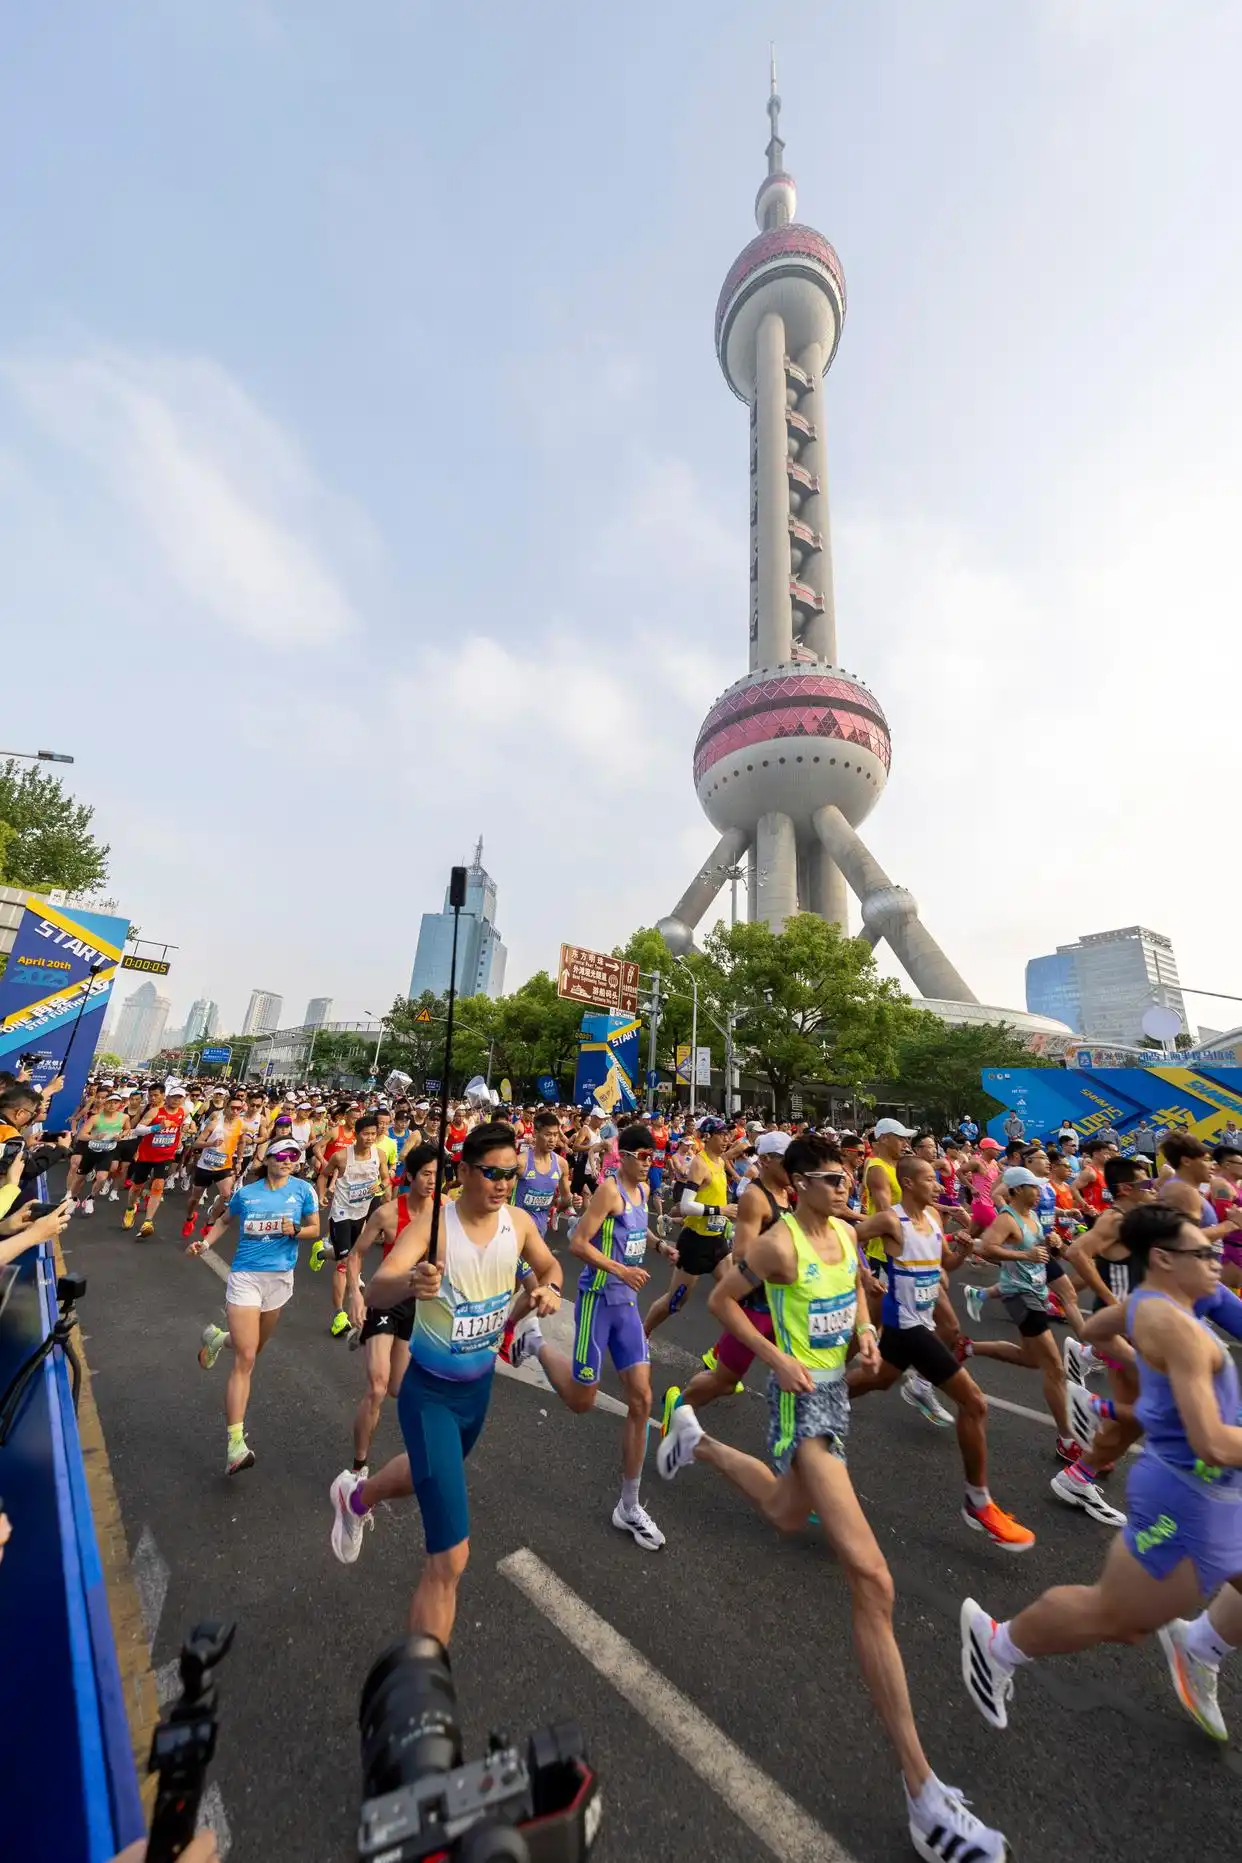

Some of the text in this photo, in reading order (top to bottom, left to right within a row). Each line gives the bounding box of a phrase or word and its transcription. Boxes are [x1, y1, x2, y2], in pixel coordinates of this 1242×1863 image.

[34, 919, 112, 968] START
[17, 956, 71, 970] April 20th
[124, 957, 168, 973] 0:00:05
[571, 949, 604, 966] 东方明珠
[2, 1017, 32, 1034] ONE
[25, 1015, 49, 1031] STEP
[612, 1028, 638, 1047] START
